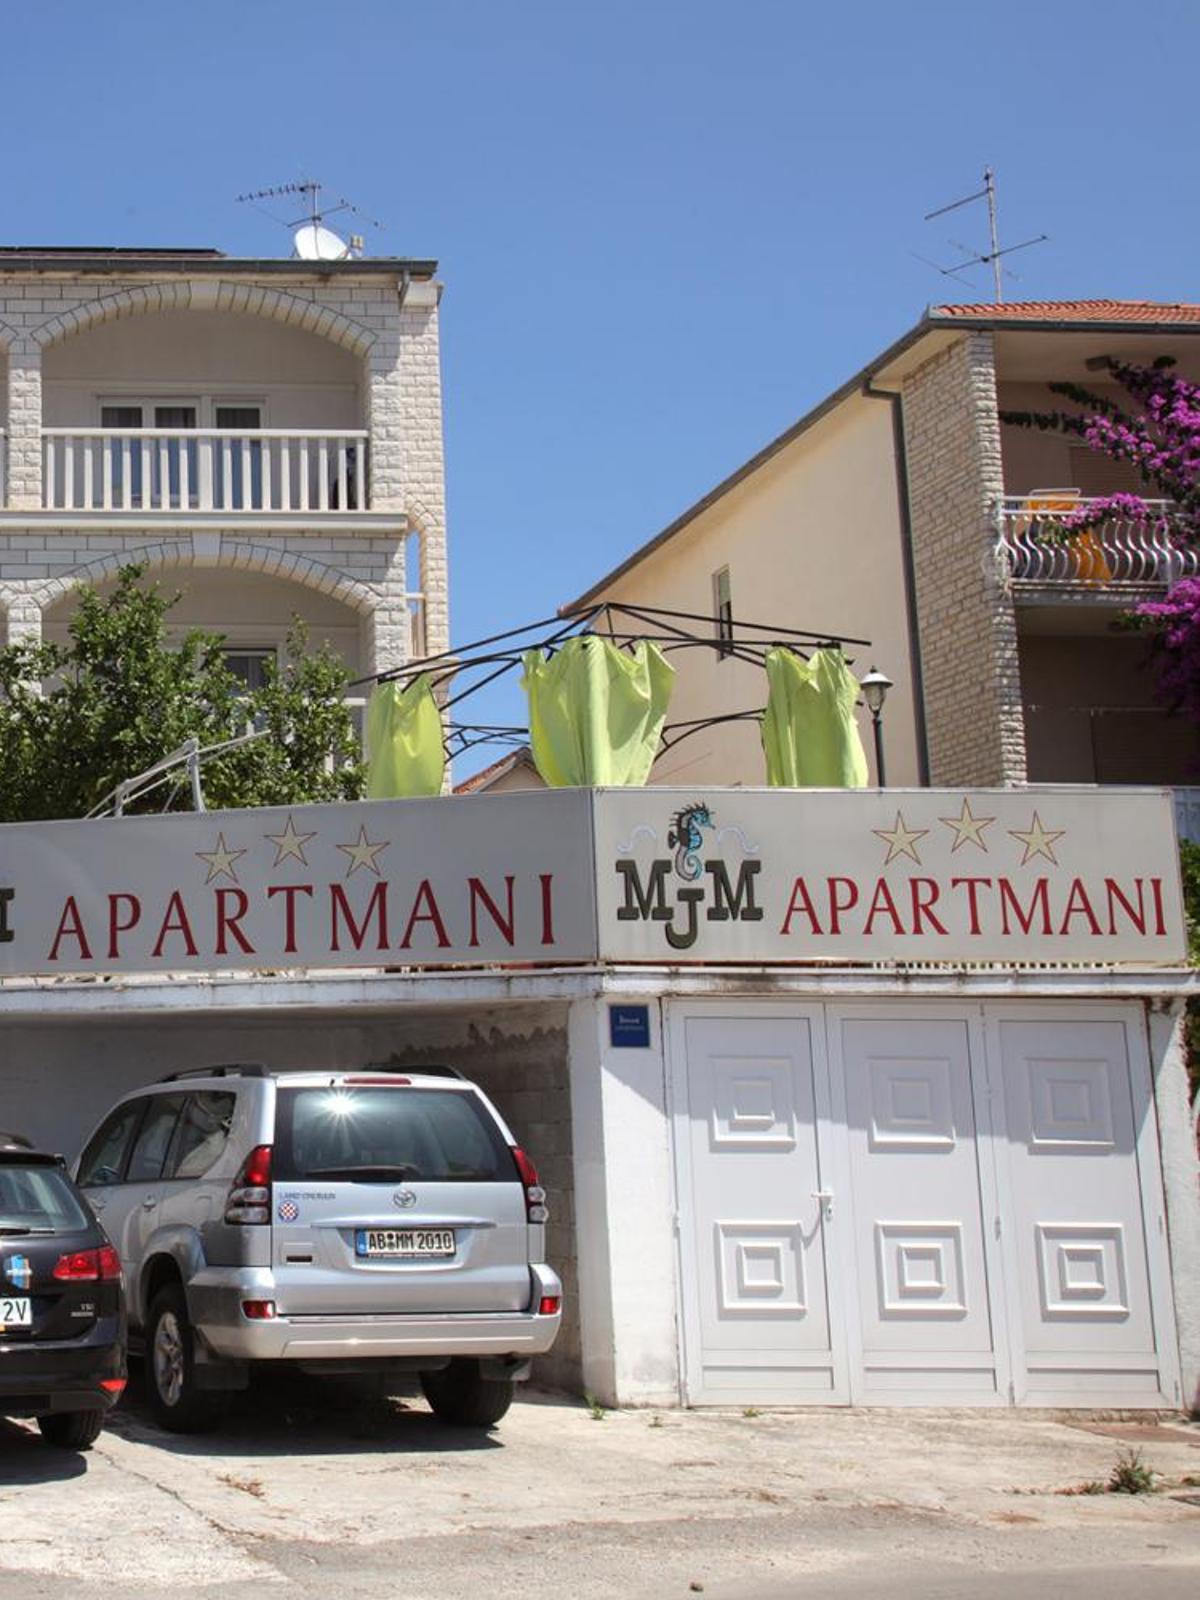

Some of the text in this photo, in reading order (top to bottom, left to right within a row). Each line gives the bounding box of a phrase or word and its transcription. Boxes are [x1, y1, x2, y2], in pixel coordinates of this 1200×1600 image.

[48, 874, 554, 960] APARTMANI
[779, 877, 1168, 936] APARTMANI
[369, 1233, 386, 1249] AB
[417, 1233, 452, 1249] 2010
